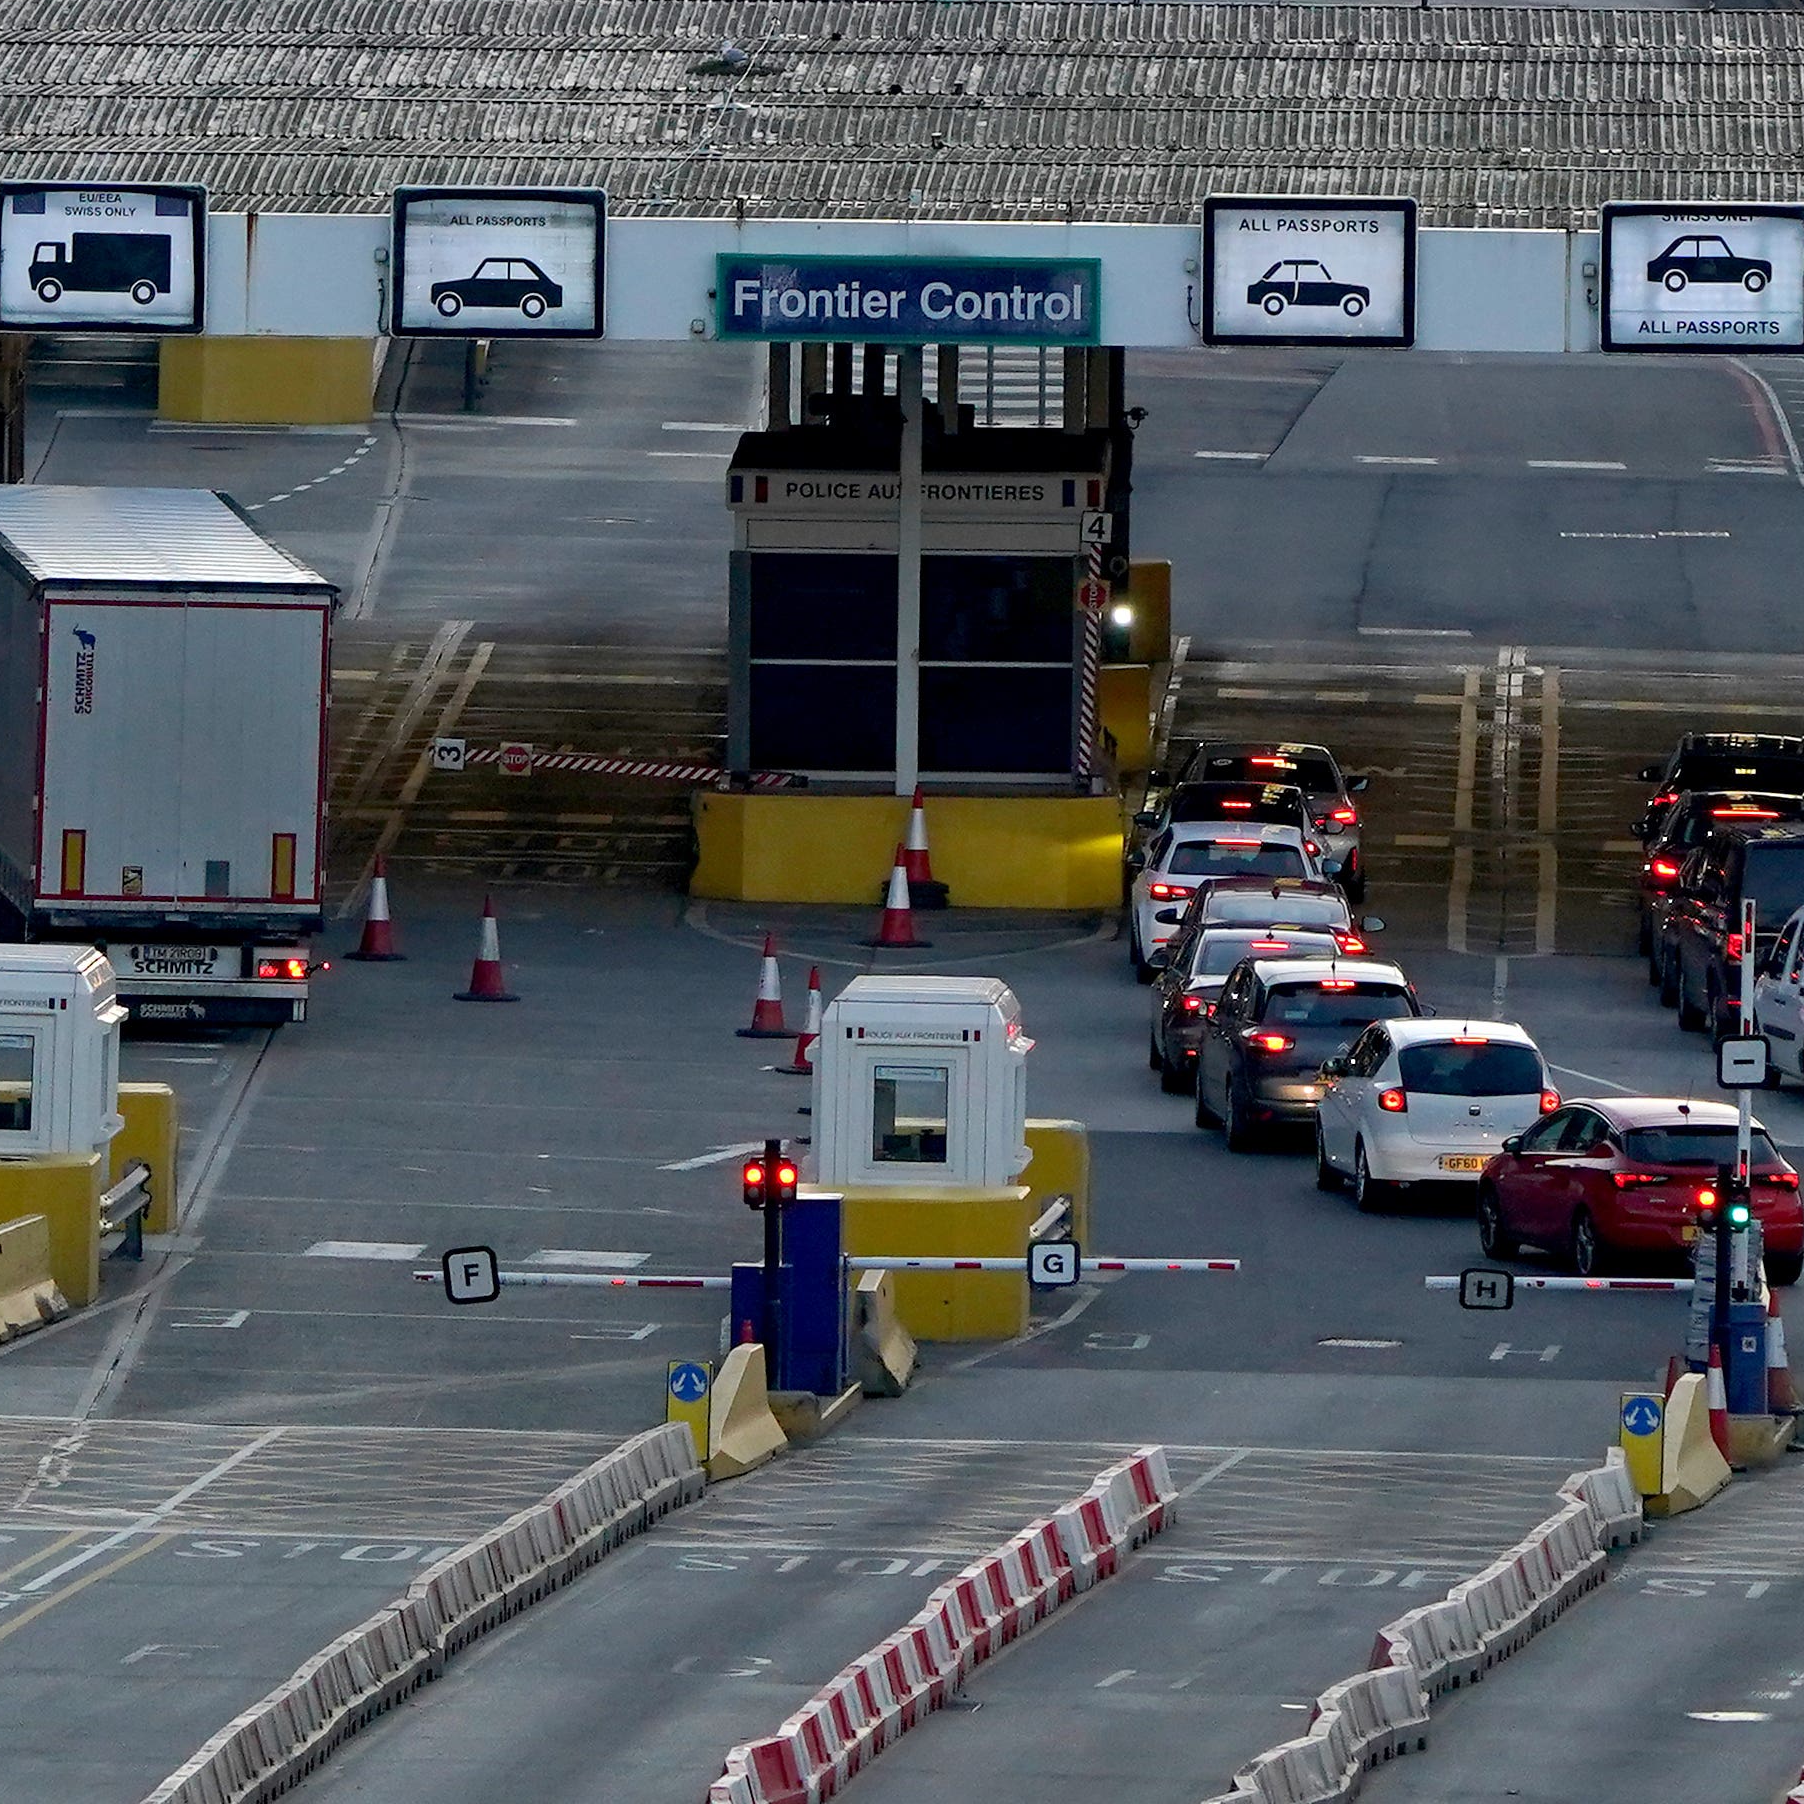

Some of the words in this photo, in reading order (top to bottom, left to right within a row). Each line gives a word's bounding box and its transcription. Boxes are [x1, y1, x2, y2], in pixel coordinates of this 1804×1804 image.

[64, 207, 101, 217] SWISS
[104, 207, 137, 217] ONLY
[449, 216, 474, 227] ALL
[476, 215, 546, 228] PASSPORTS
[1239, 218, 1271, 232] ALL
[1277, 219, 1379, 234] PASSPORTS
[733, 280, 906, 320] Frontier
[920, 281, 1084, 322] Control
[1639, 320, 1672, 334] ALL
[1676, 320, 1781, 335] PASSPORTS
[786, 483, 863, 500] POLICE
[920, 483, 1045, 502] RONTIERES
[1086, 515, 1106, 539] 4
[74, 651, 87, 715] SCHMITZ
[438, 746, 461, 763] 3
[504, 754, 529, 765] STOP
[133, 960, 214, 975] SCHMITZ
[1448, 1158, 1478, 1170] GF60
[1043, 1253, 1065, 1274] G
[463, 1264, 480, 1288] F
[1477, 1279, 1497, 1299] H
